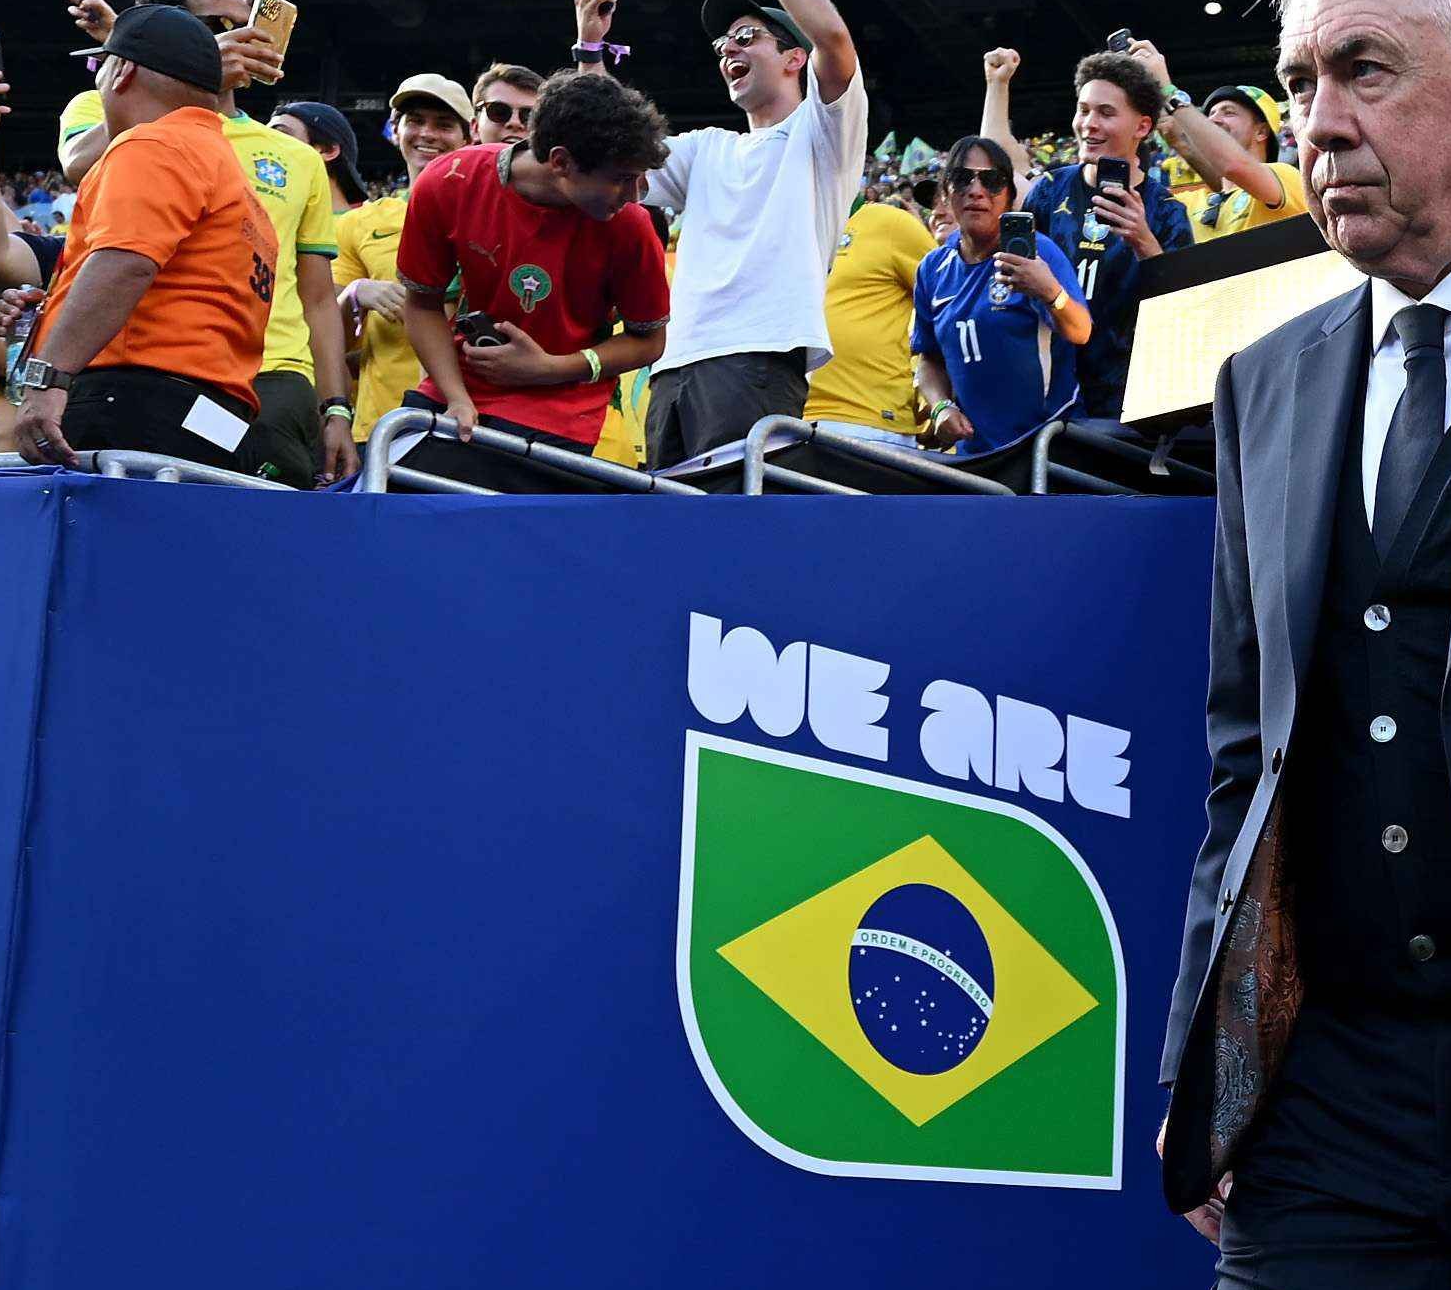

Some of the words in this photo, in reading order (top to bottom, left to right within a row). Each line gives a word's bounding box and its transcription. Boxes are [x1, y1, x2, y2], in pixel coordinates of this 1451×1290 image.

[687, 611, 891, 762] WE
[860, 932, 907, 950] ORDEM
[911, 946, 918, 955] E
[920, 949, 989, 1008] PROGRESSO
